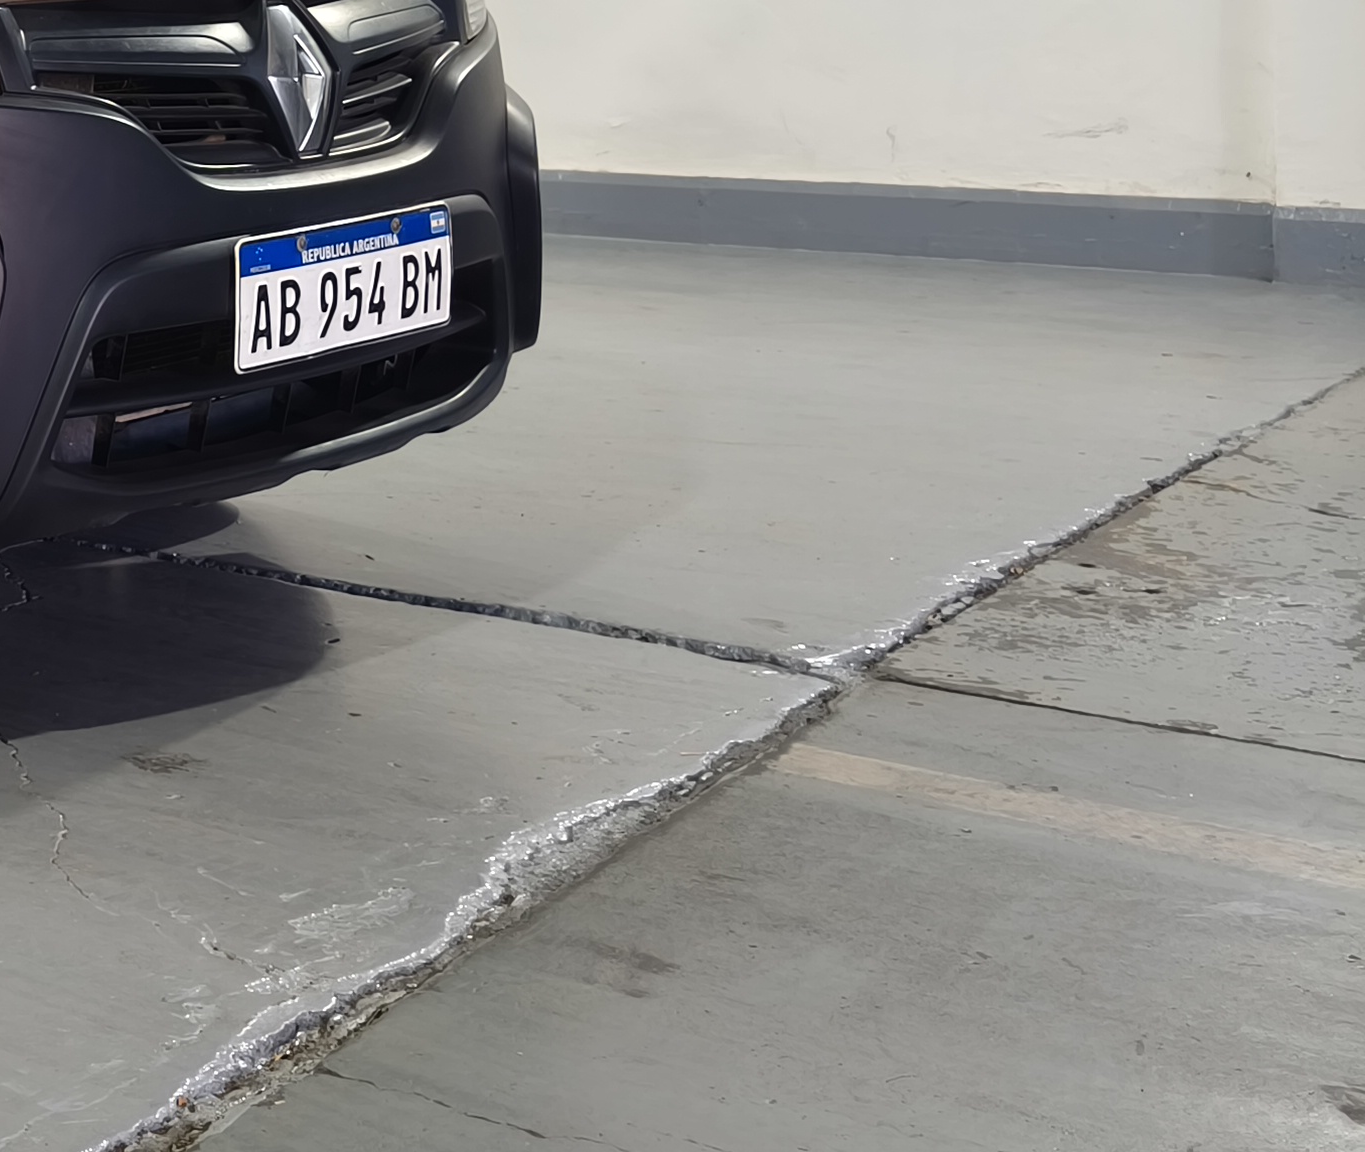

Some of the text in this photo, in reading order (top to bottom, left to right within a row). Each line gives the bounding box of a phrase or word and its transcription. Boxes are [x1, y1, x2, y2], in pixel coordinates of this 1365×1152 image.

[302, 232, 400, 264] REPUBLICA ARGENTINA
[251, 248, 442, 354] AB 954 BM
